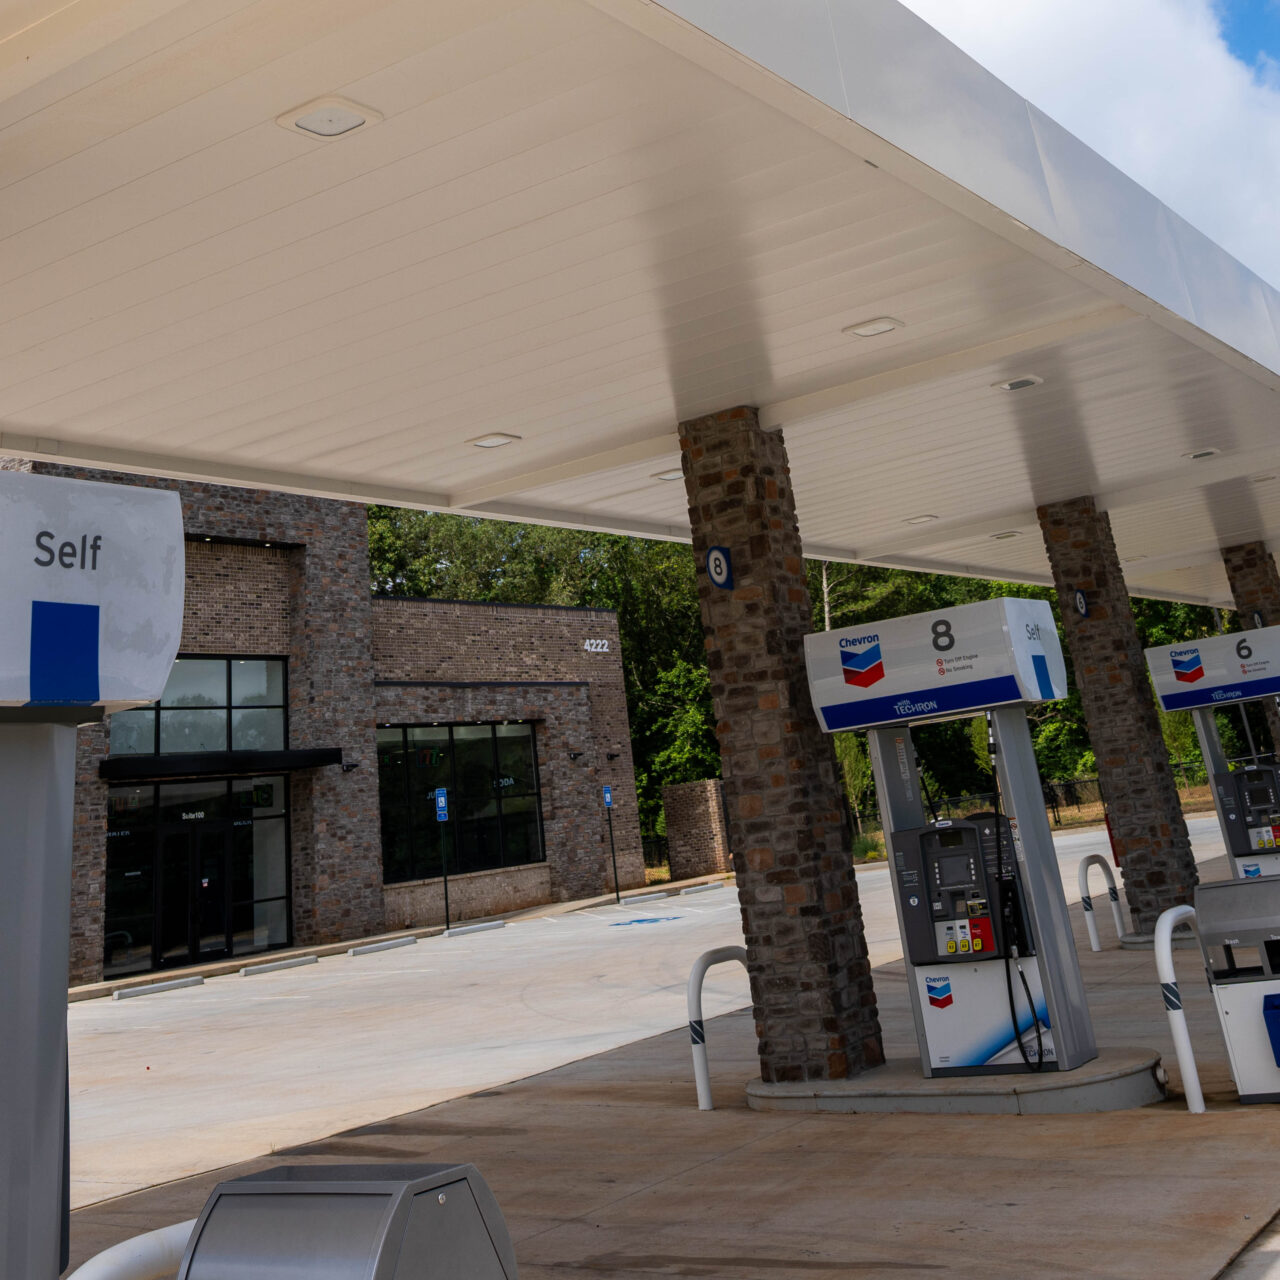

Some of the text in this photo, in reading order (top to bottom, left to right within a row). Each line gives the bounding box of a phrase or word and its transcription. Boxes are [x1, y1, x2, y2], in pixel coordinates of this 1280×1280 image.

[34, 530, 102, 571] Self
[714, 557, 723, 576] 8
[931, 619, 955, 651] 8
[1026, 624, 1041, 641] Self
[584, 639, 609, 652] 4222
[839, 634, 880, 648] Chevron
[1236, 638, 1252, 659] 6
[1170, 648, 1199, 658] Chevron
[893, 700, 937, 715] TECHRON
[897, 698, 911, 706] with
[493, 776, 515, 787] ODA
